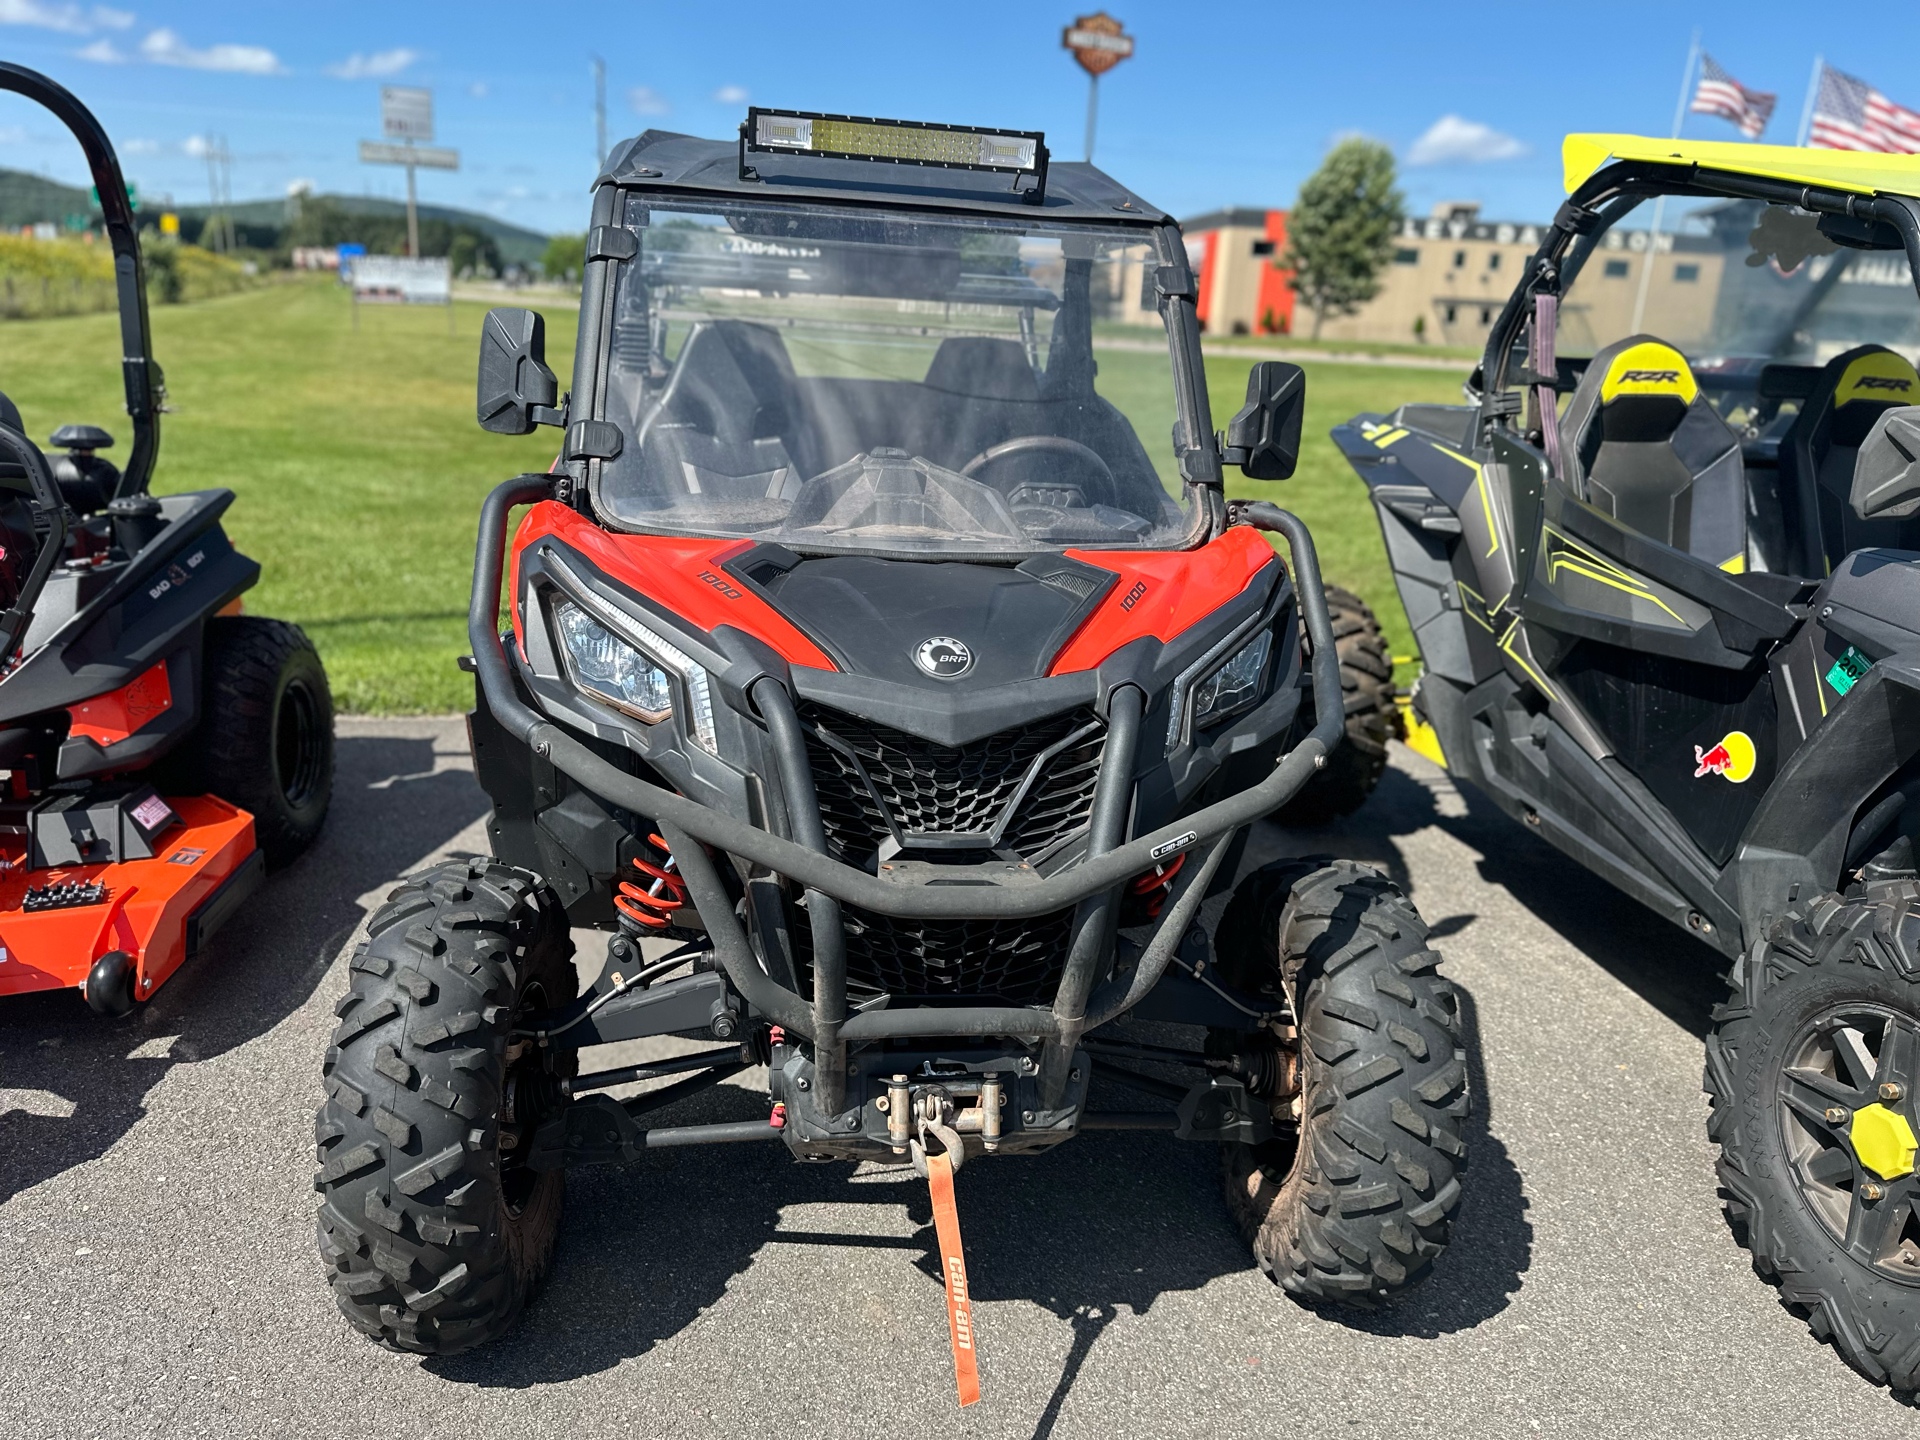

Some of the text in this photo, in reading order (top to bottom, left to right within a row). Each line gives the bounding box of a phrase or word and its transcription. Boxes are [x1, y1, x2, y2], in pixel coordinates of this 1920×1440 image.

[1617, 370, 1681, 384] RZR
[1853, 376, 1912, 392] RZR
[149, 579, 171, 599] BAD
[697, 570, 743, 599] 1000
[1120, 581, 1147, 613] 1000
[940, 654, 967, 663] BRP
[1161, 836, 1189, 853] can-am
[948, 1256, 971, 1350] can-am
